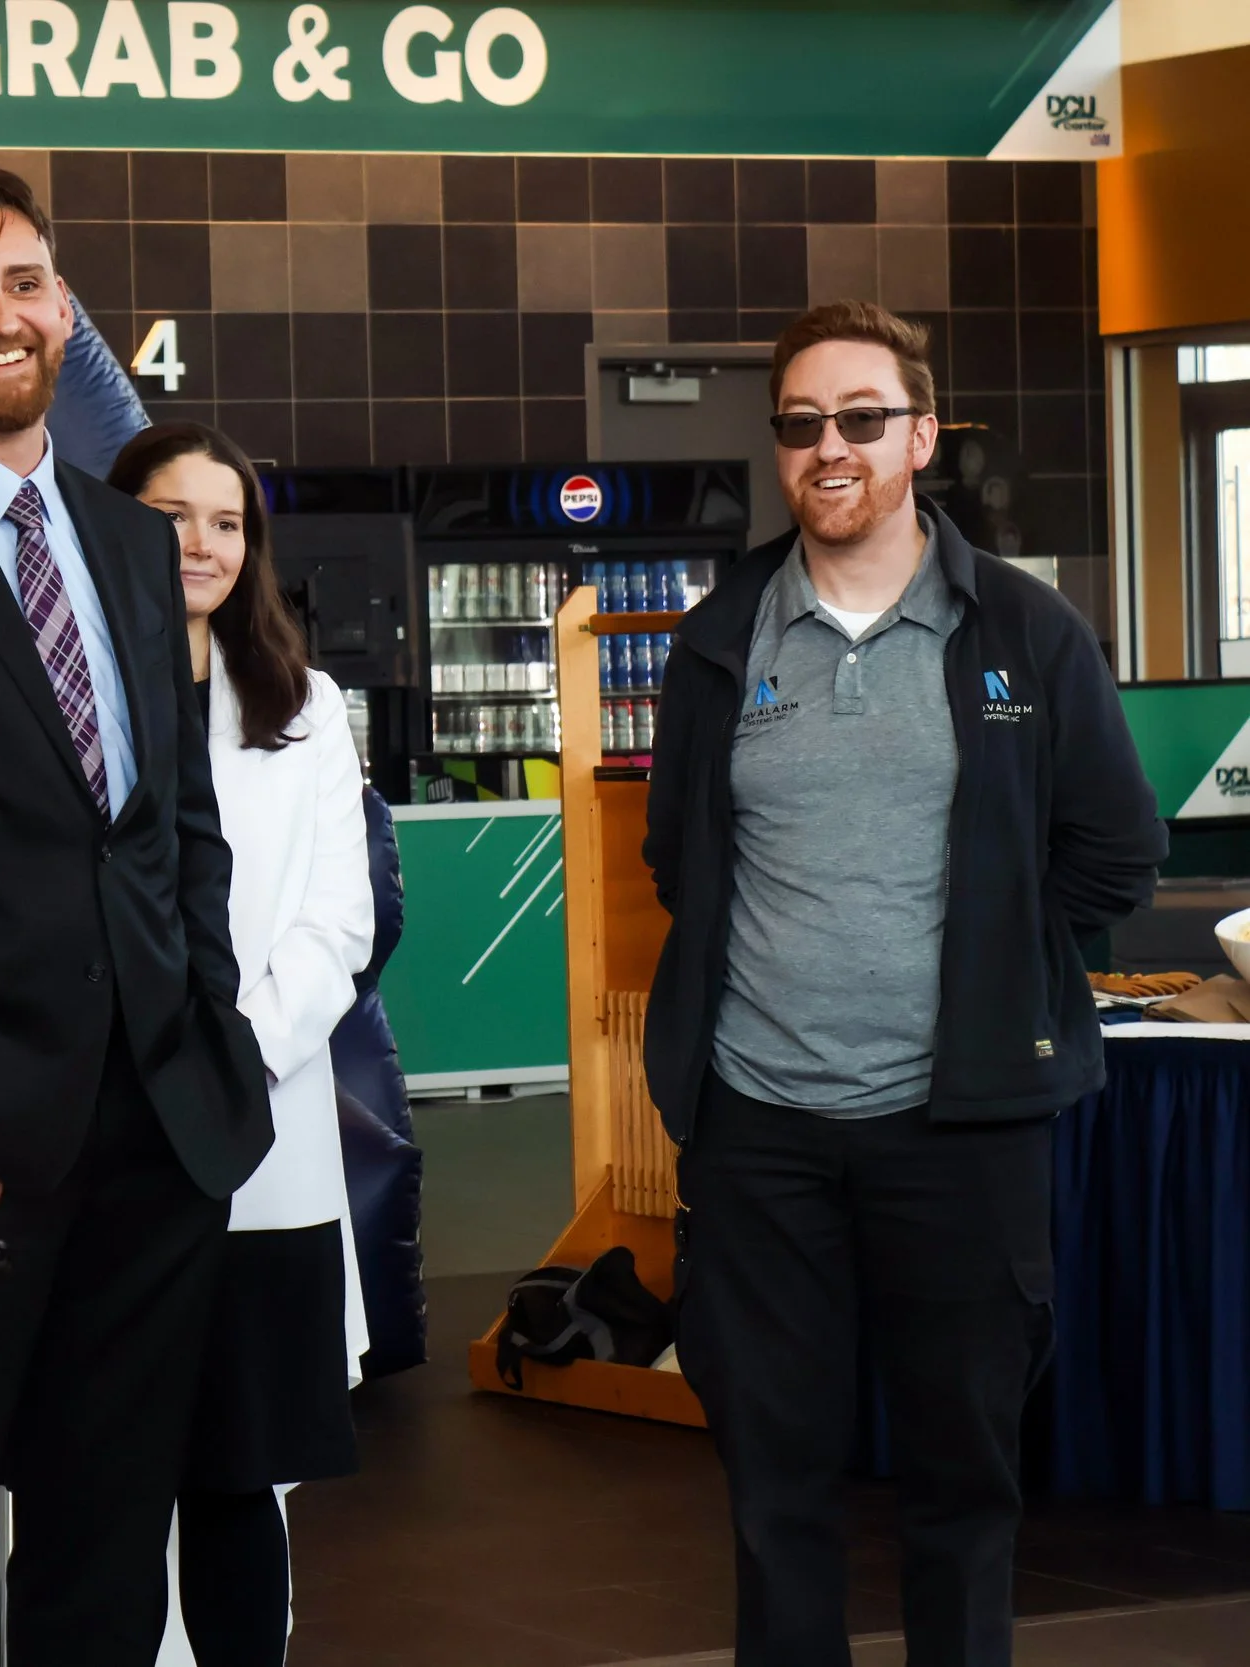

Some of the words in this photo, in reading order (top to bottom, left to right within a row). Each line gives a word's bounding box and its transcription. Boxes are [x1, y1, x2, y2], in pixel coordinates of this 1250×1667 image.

[273, 3, 351, 102] &
[382, 5, 548, 106] GO
[1046, 95, 1096, 118] DCU
[130, 319, 185, 392] 4
[563, 493, 598, 503] PEPSI
